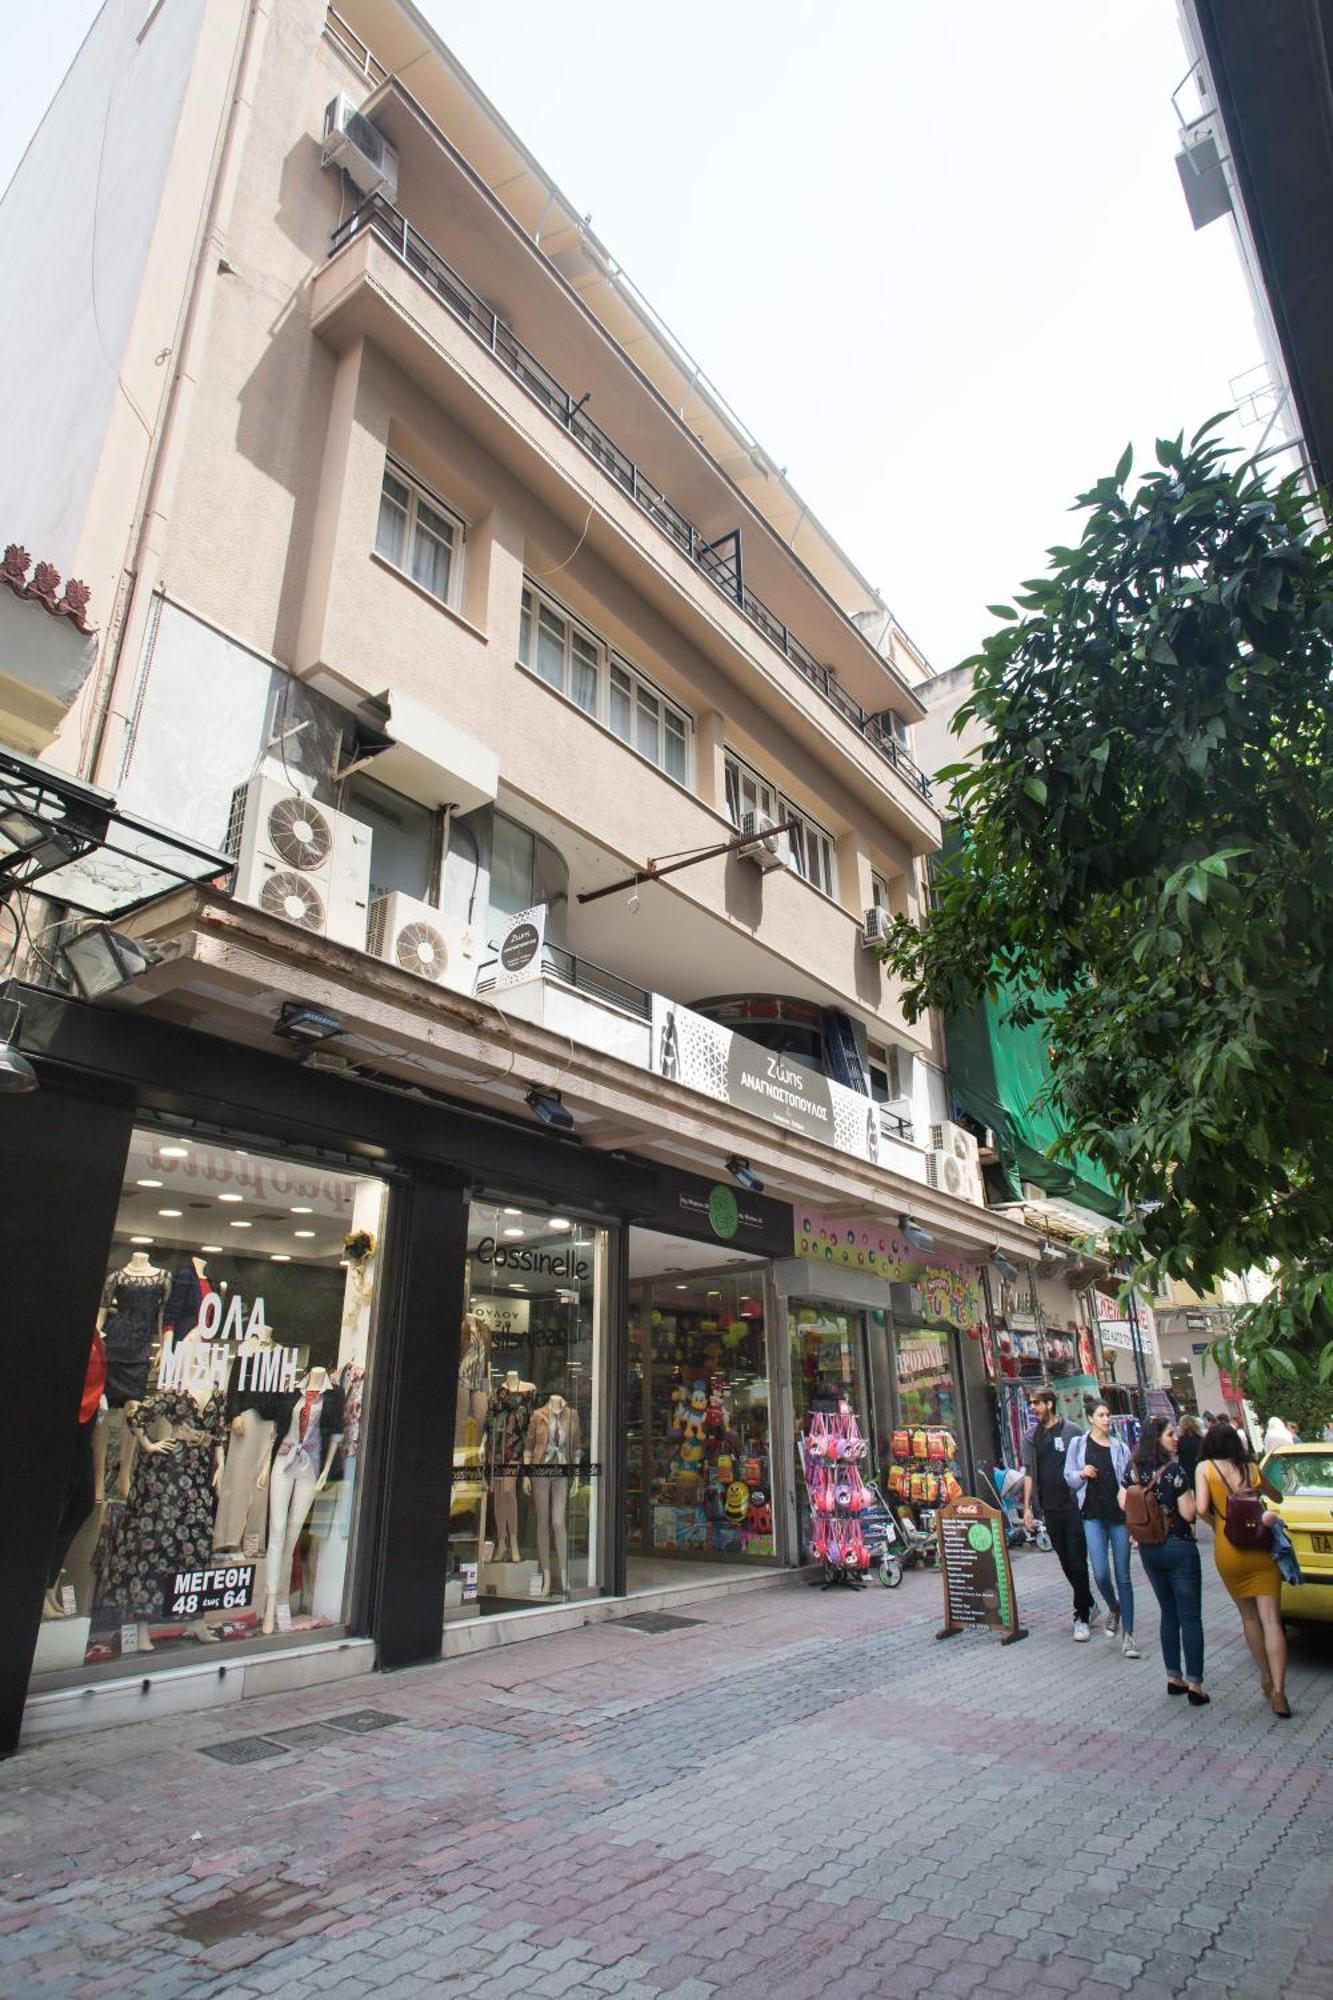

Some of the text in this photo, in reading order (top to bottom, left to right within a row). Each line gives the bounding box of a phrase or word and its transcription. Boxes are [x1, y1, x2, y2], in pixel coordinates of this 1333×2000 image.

[741, 1071, 828, 1121] ΑΝΑΓΝΩΣΤΟΠΟΥΛΟΣ
[198, 1291, 265, 1341] ΟΛΑ
[469, 1302, 519, 1319] ΟΥΛΟΥ
[157, 1333, 298, 1393] ΜΙΣΗ ΤΙΜΗ
[174, 1567, 252, 1594] ΜΕΓΕΘΗ
[172, 1594, 198, 1613] 48
[223, 1589, 247, 1609] 64
